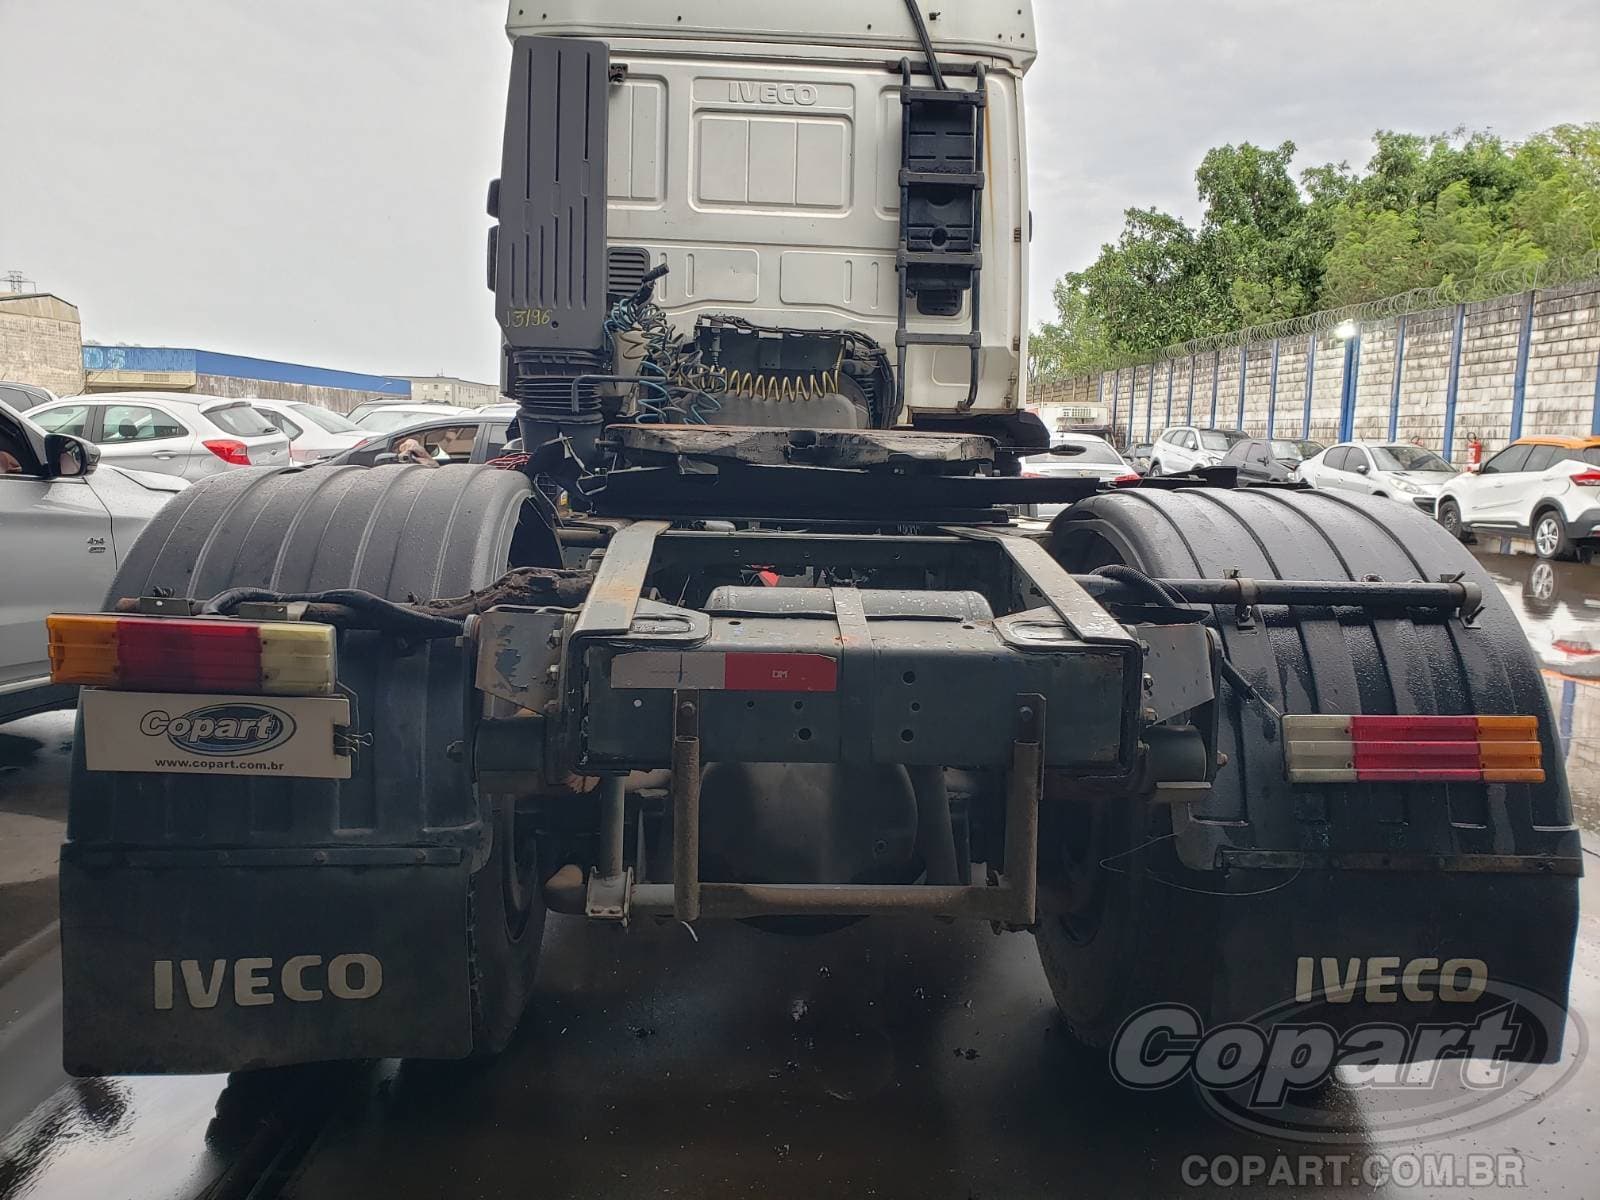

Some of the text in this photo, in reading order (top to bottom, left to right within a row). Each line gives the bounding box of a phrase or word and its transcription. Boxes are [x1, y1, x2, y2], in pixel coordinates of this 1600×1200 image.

[728, 81, 817, 106] IVECO
[140, 709, 276, 743] Copart
[154, 758, 285, 771] www.copart.com.br
[154, 953, 383, 1010] IVECO
[1295, 956, 1488, 1004] IVECO
